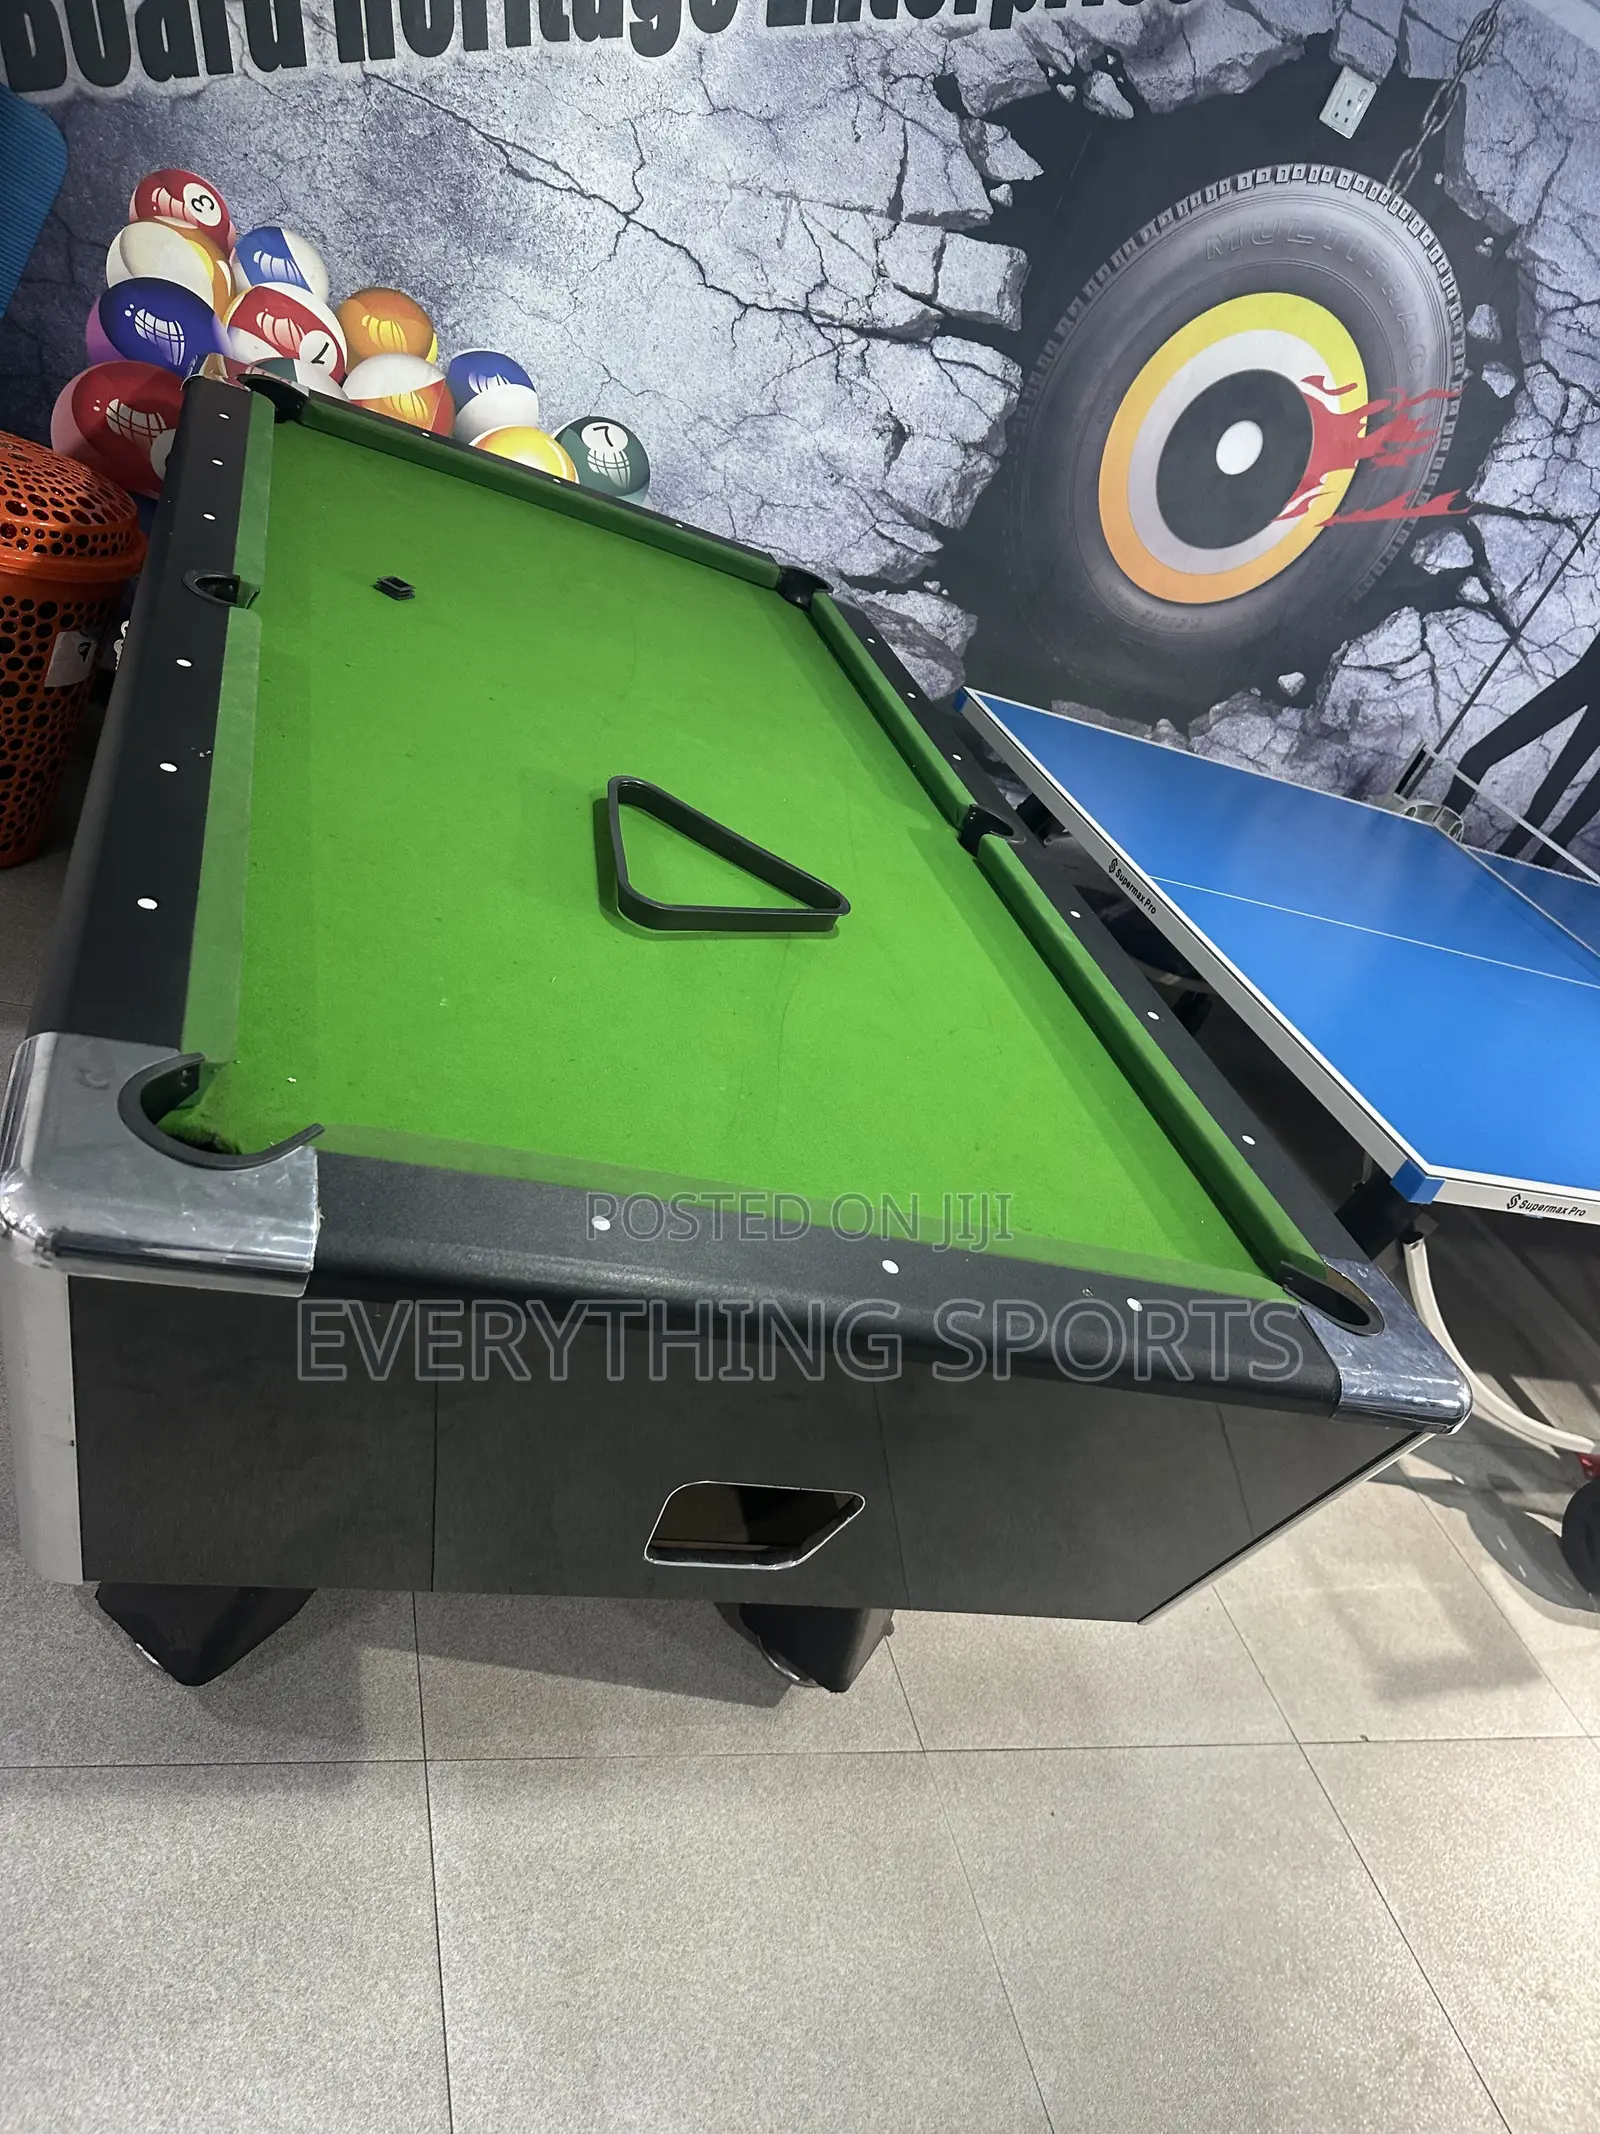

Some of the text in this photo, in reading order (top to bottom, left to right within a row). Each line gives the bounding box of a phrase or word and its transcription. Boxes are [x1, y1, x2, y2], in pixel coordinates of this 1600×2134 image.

[191, 194, 215, 213] 3
[592, 425, 614, 447] 7
[1115, 868, 1146, 904] Supermax
[1143, 898, 1157, 915] Pro
[1518, 1200, 1569, 1215] Supermax
[1567, 1206, 1587, 1217] Pro
